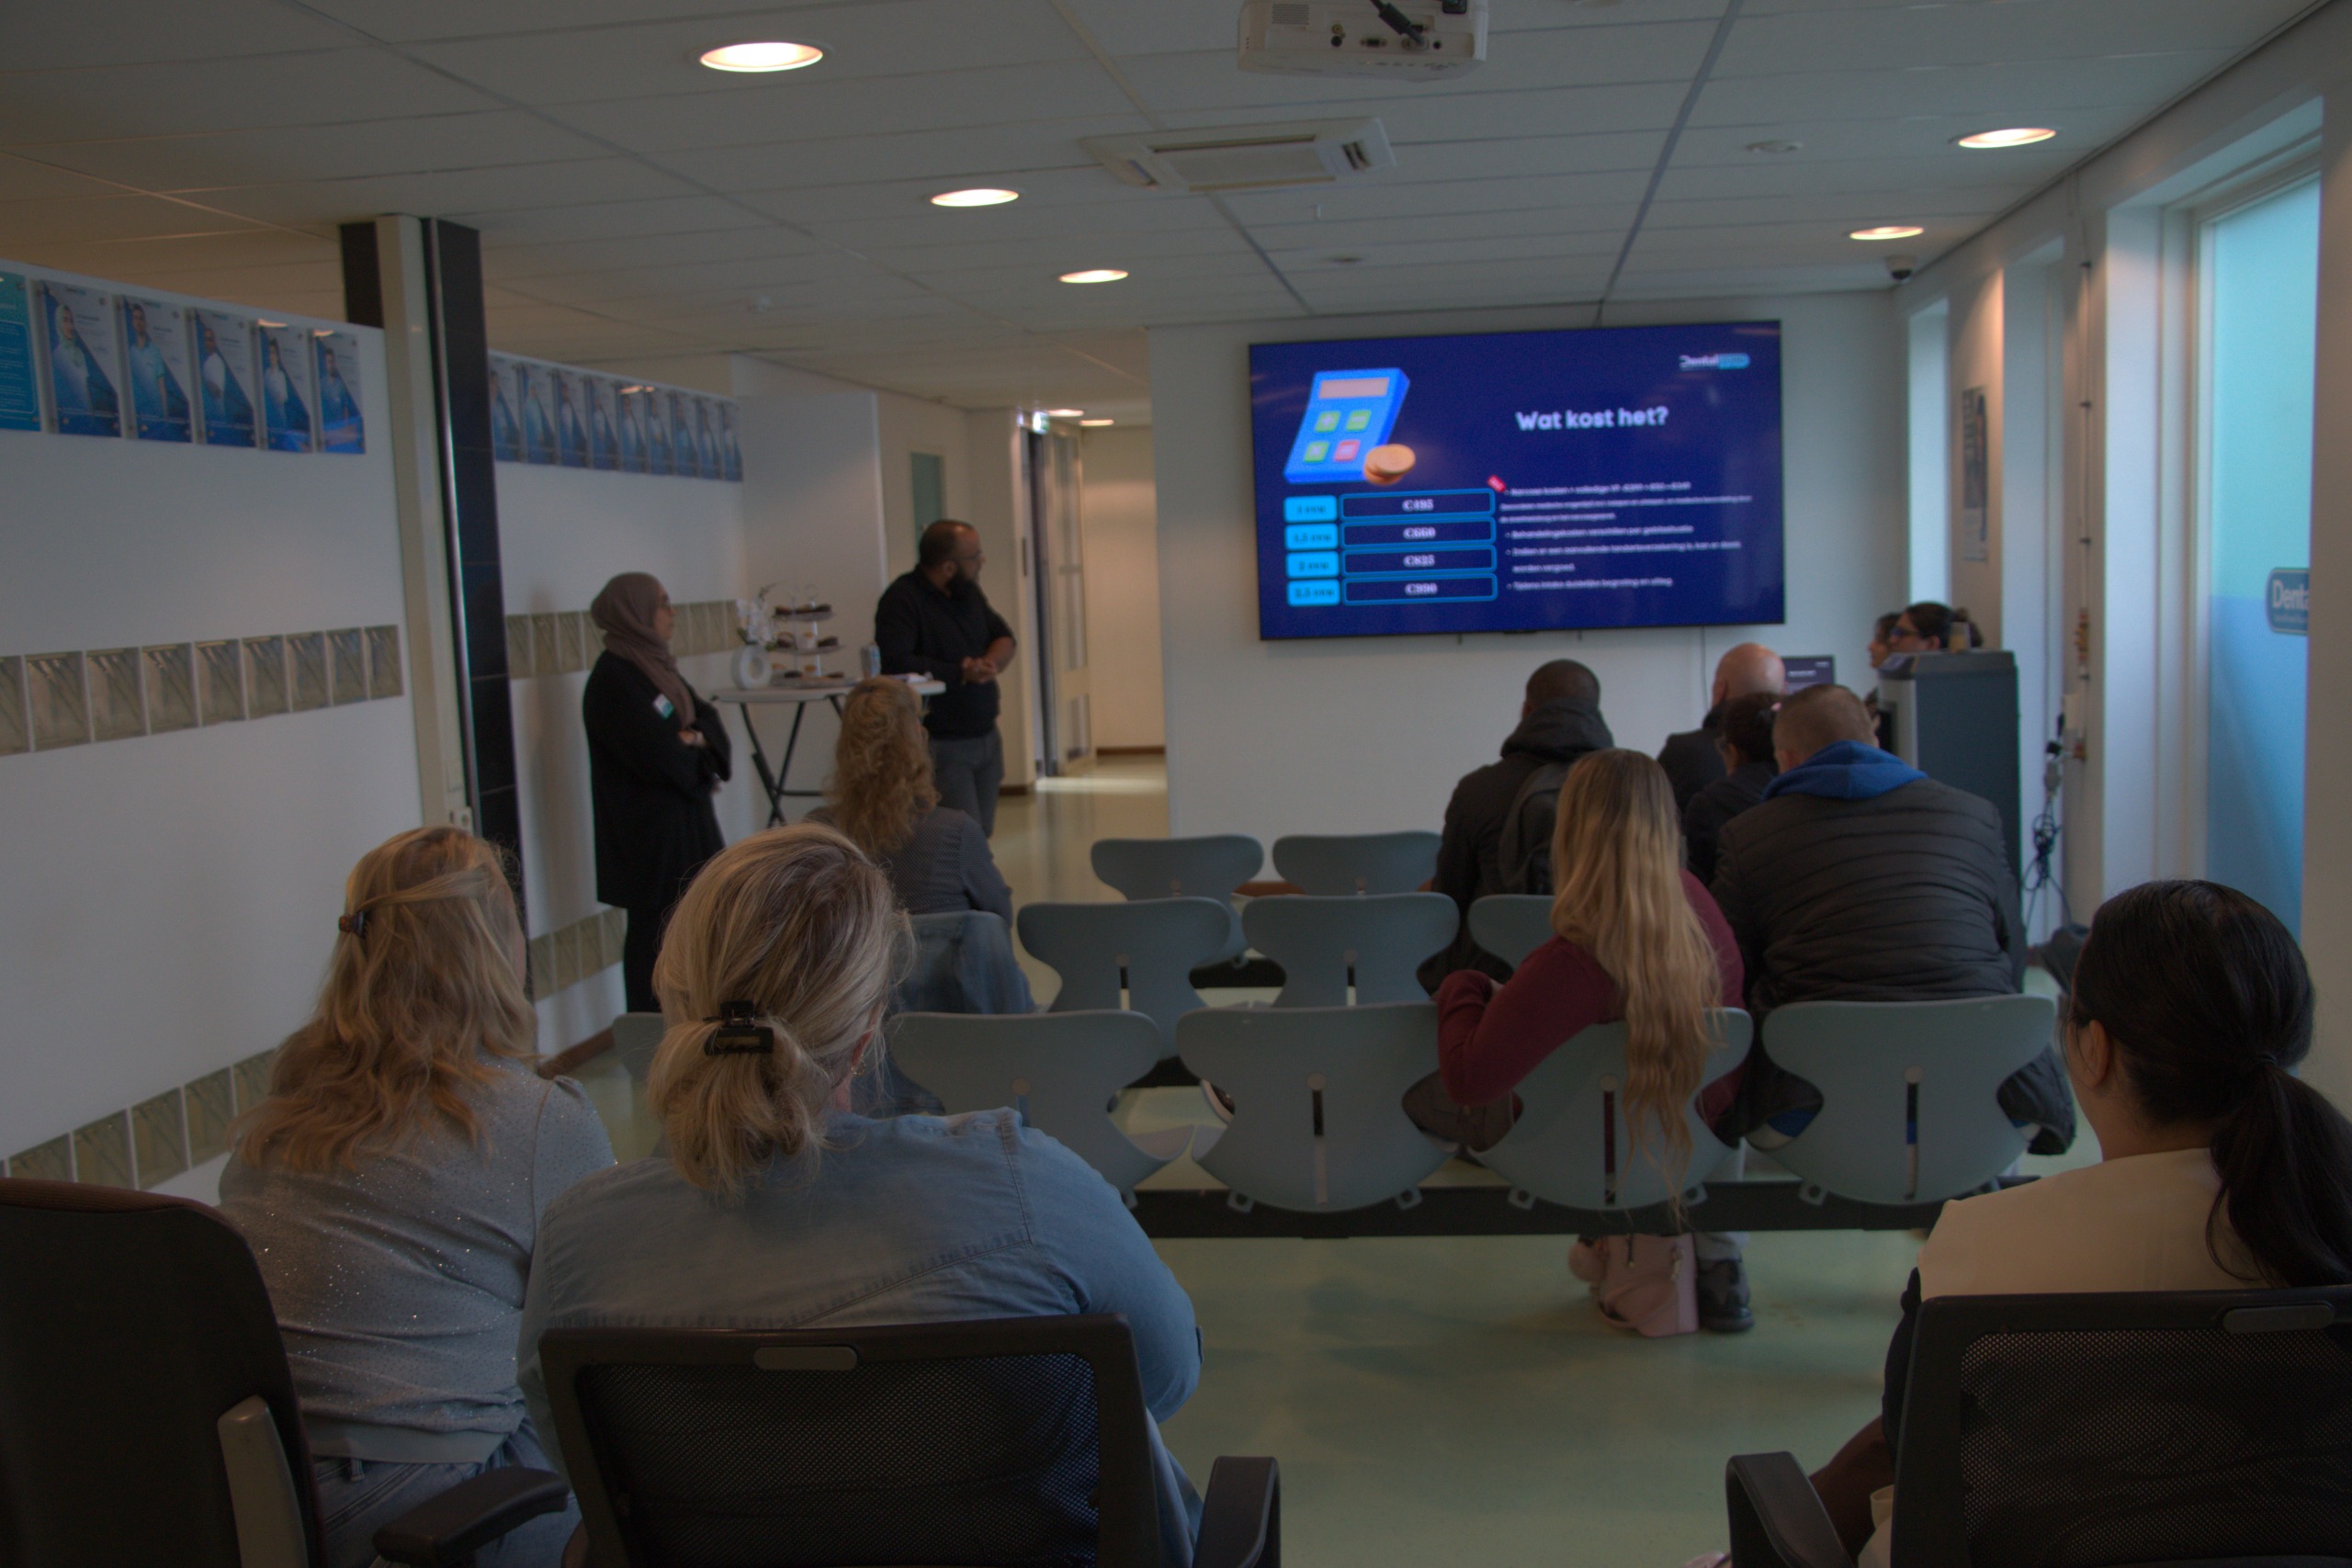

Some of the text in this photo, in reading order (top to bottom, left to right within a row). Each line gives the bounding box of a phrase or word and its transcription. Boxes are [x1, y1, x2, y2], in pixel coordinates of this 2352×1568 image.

[1515, 405, 1669, 431] Wat kost het?
